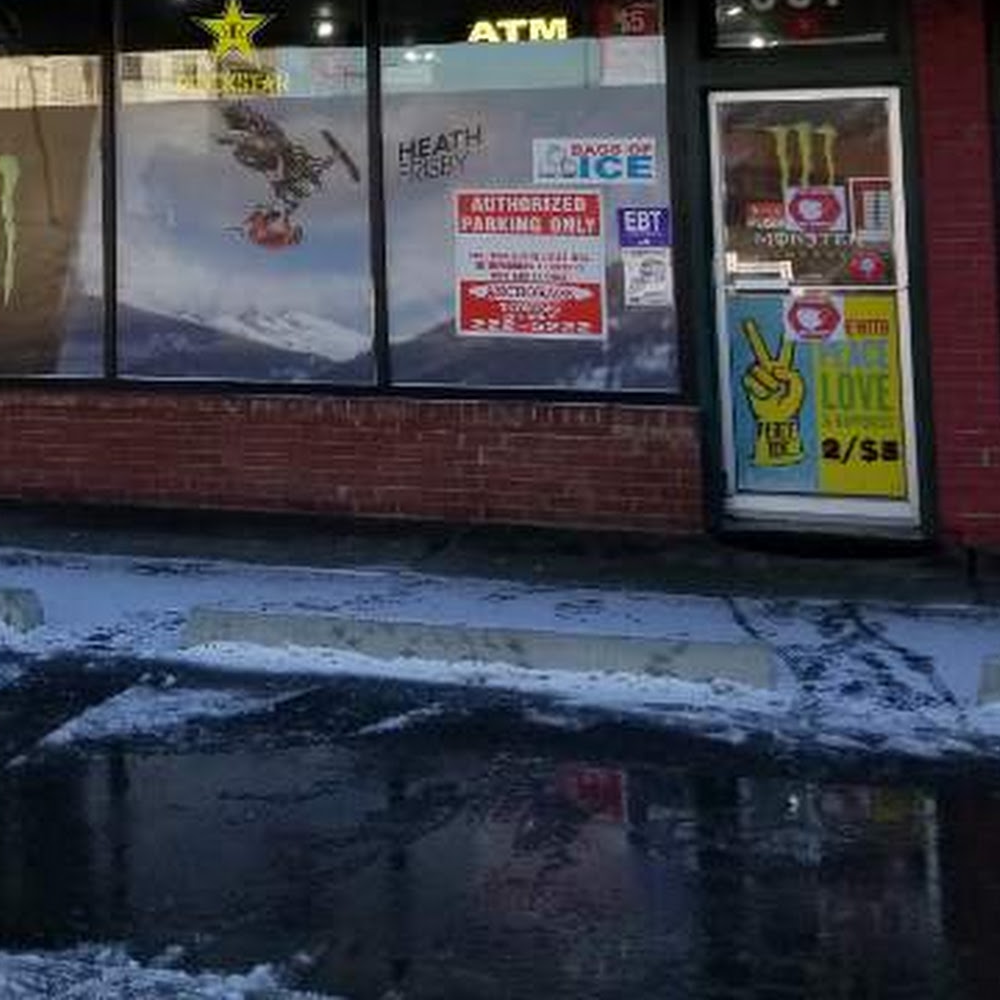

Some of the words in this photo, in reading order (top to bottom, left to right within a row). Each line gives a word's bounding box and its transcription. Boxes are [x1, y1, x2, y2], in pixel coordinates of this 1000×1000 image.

[467, 16, 567, 42] ATM
[398, 125, 482, 162] HEATH
[578, 155, 653, 179] ICE
[470, 195, 586, 213] AUTHORIZED
[461, 214, 541, 232] PARKING
[550, 217, 597, 233] ONLY
[624, 210, 662, 232] EBT
[821, 369, 889, 412] LOVE
